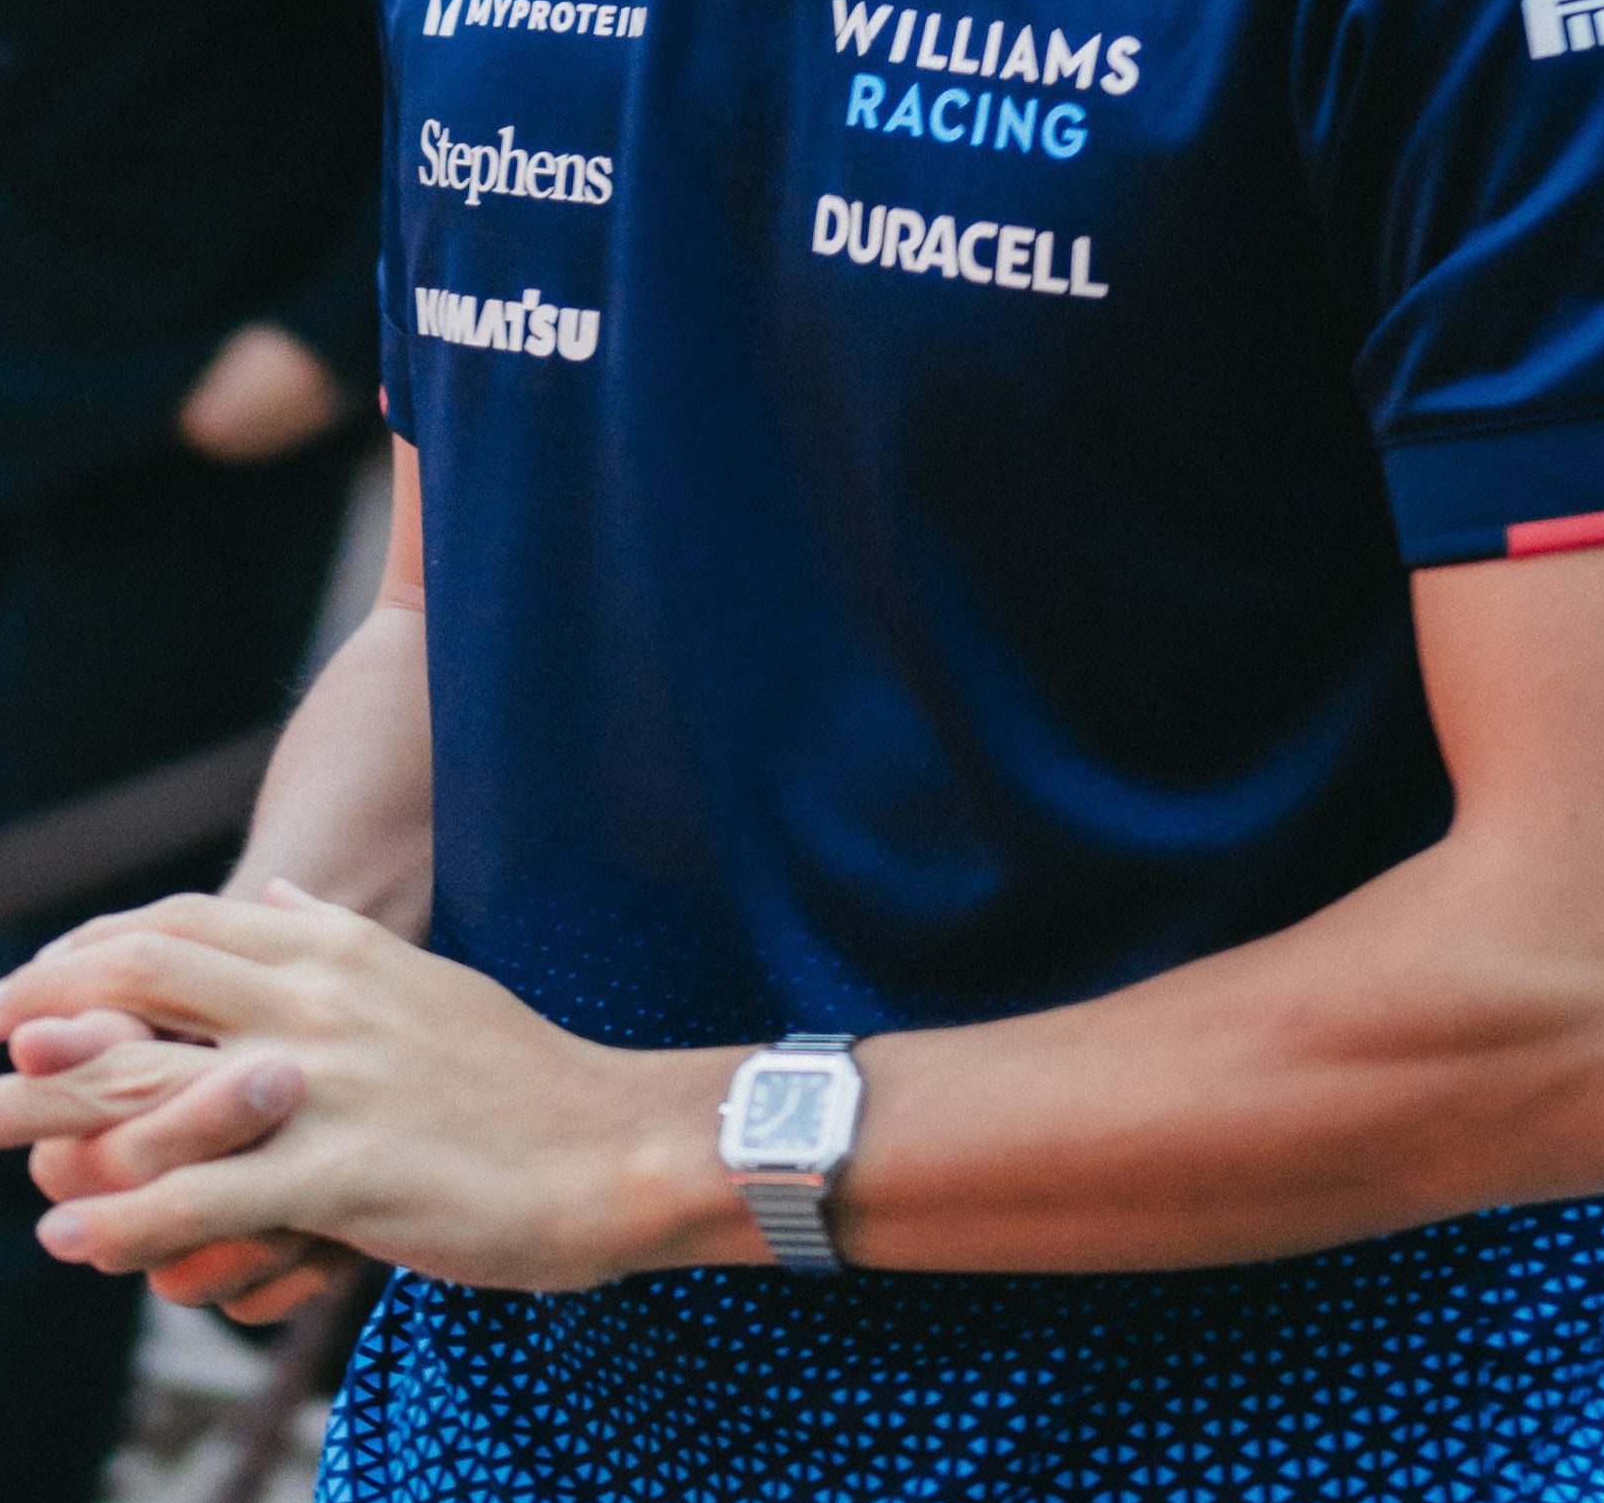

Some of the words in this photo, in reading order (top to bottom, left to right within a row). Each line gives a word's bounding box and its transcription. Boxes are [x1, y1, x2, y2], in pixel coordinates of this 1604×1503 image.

[845, 72, 1089, 160] RACING
[418, 118, 614, 206] Stephens
[811, 193, 1110, 299] DURACELL
[414, 286, 601, 362] KMATSU
